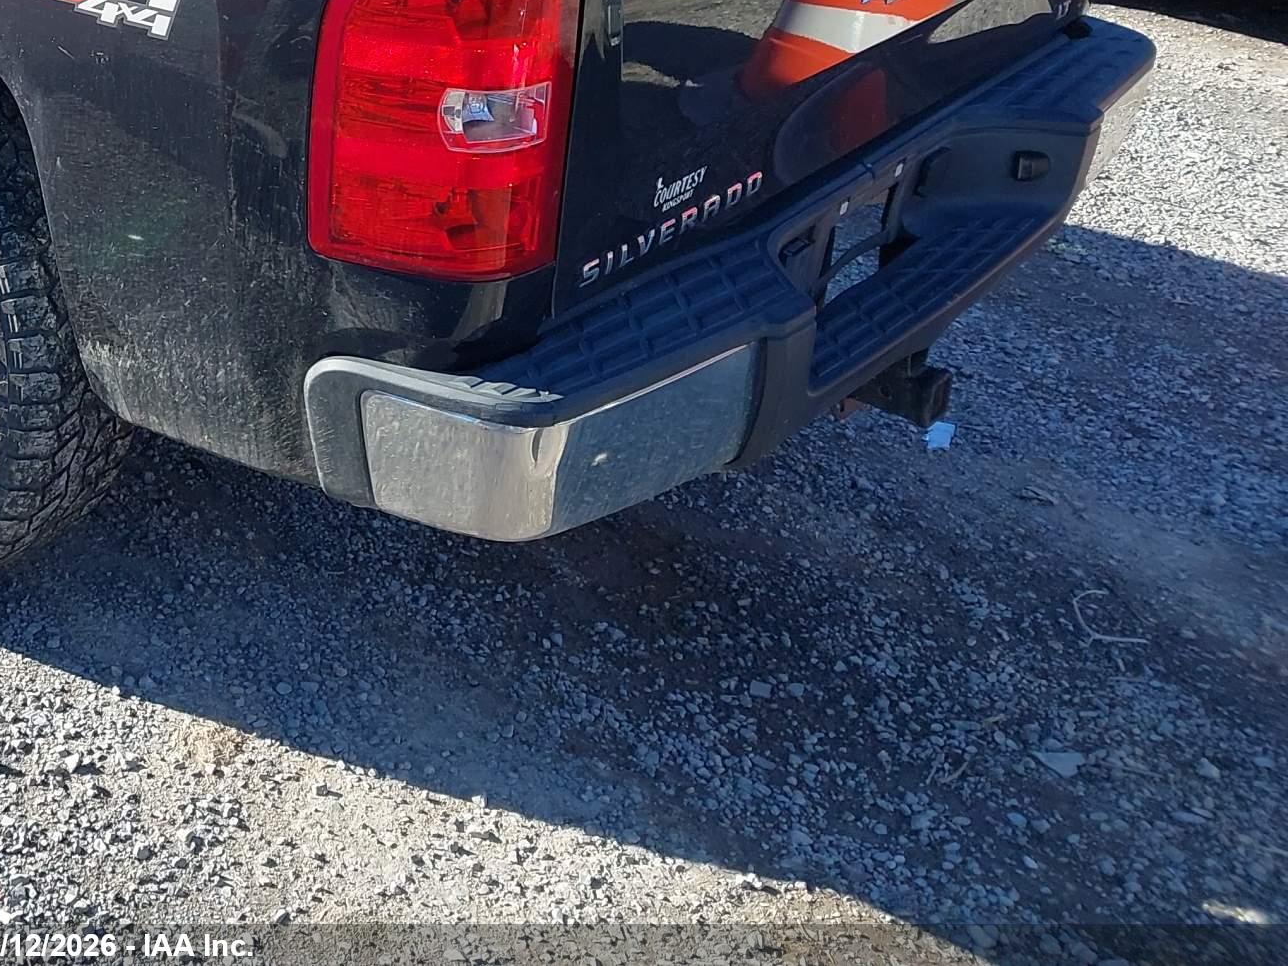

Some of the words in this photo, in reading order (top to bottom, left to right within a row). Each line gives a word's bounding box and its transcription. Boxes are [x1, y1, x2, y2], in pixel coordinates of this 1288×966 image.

[653, 165, 709, 208] COURTESY
[662, 189, 695, 213] KINGSPORT
[579, 170, 763, 288] SILVERADO
